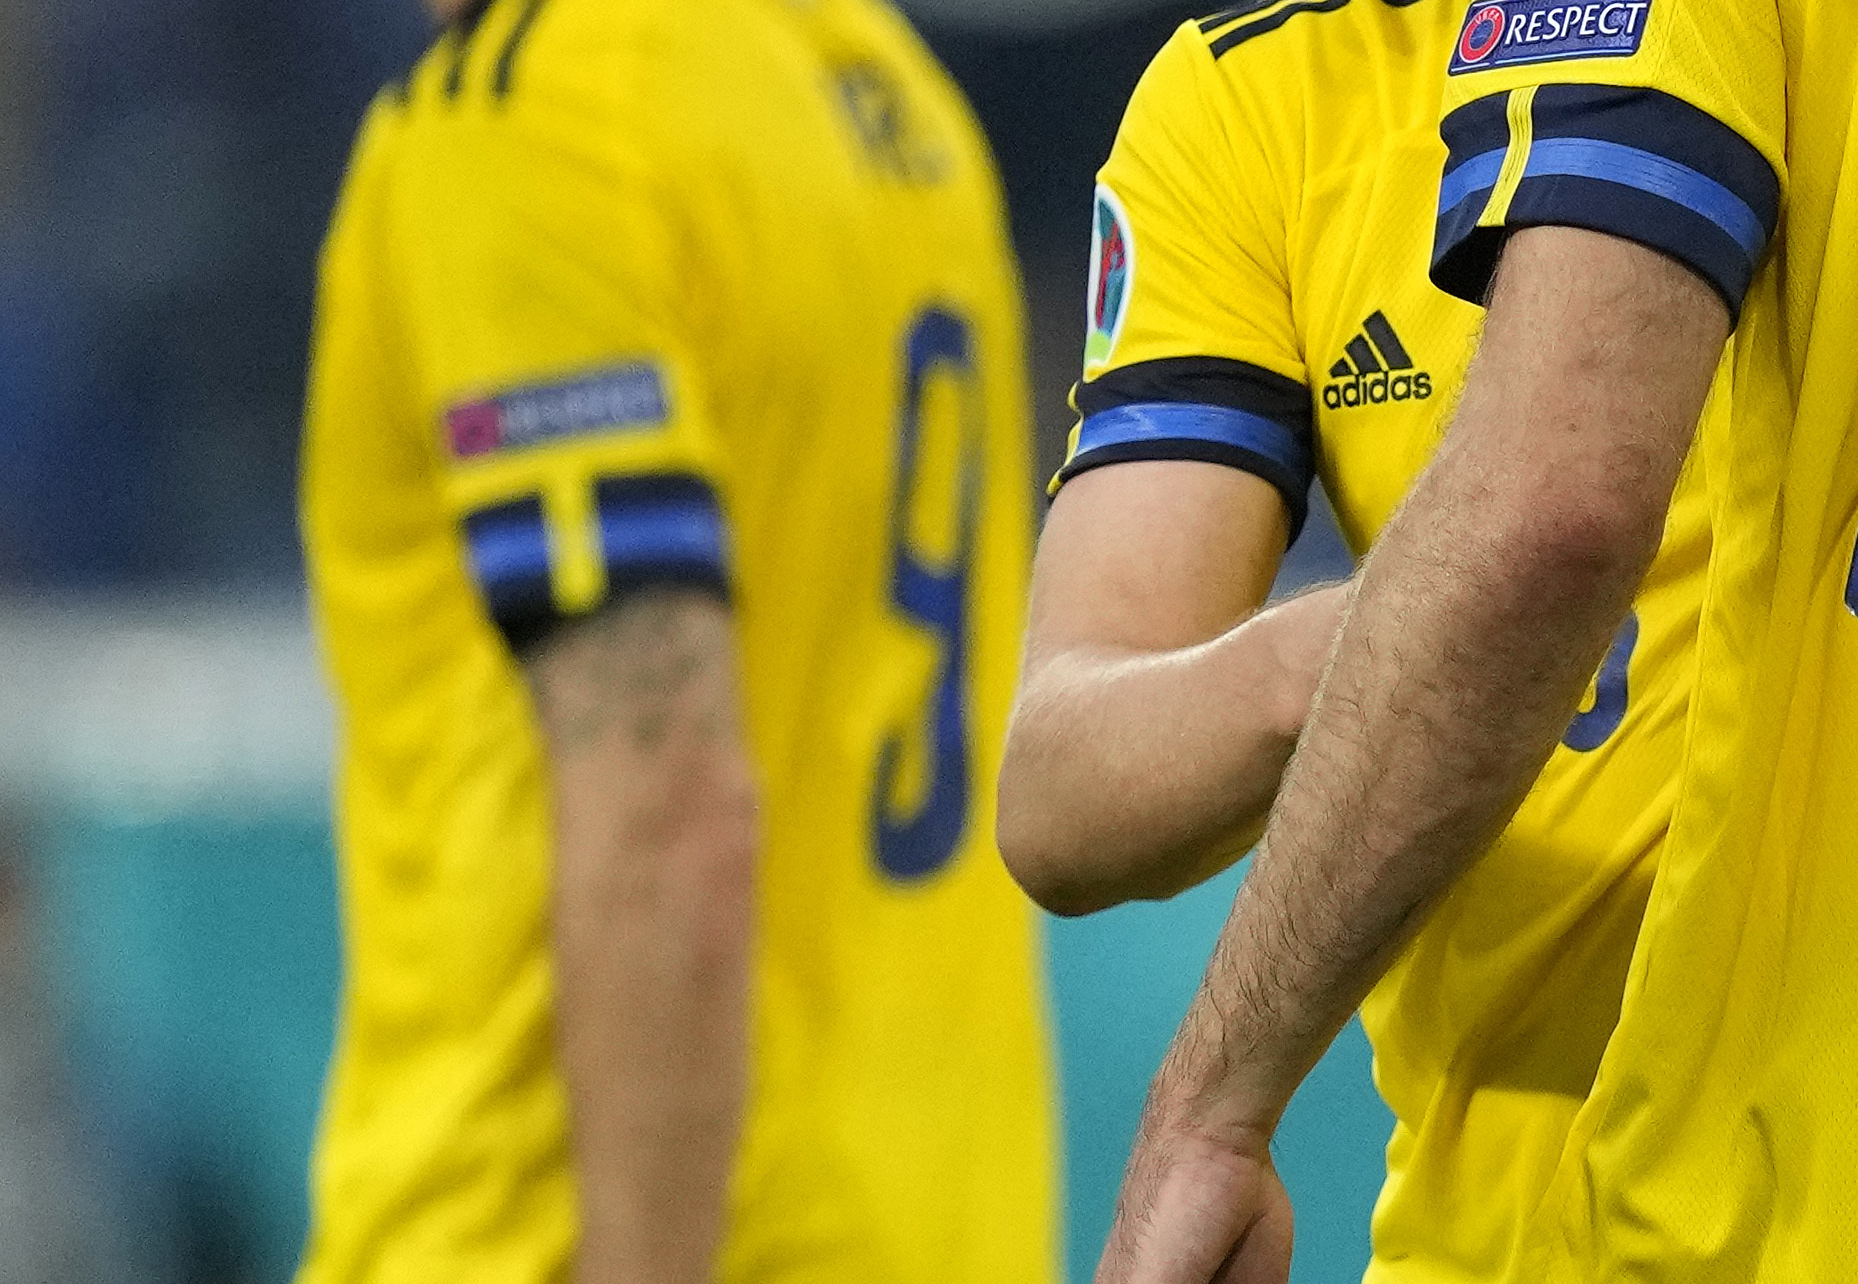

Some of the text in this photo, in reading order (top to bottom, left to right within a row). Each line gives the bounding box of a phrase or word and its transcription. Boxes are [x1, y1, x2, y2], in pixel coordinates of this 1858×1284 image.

[1504, 2, 1647, 46] RESPECT
[1322, 370, 1432, 410] adidas
[866, 297, 972, 889] 9
